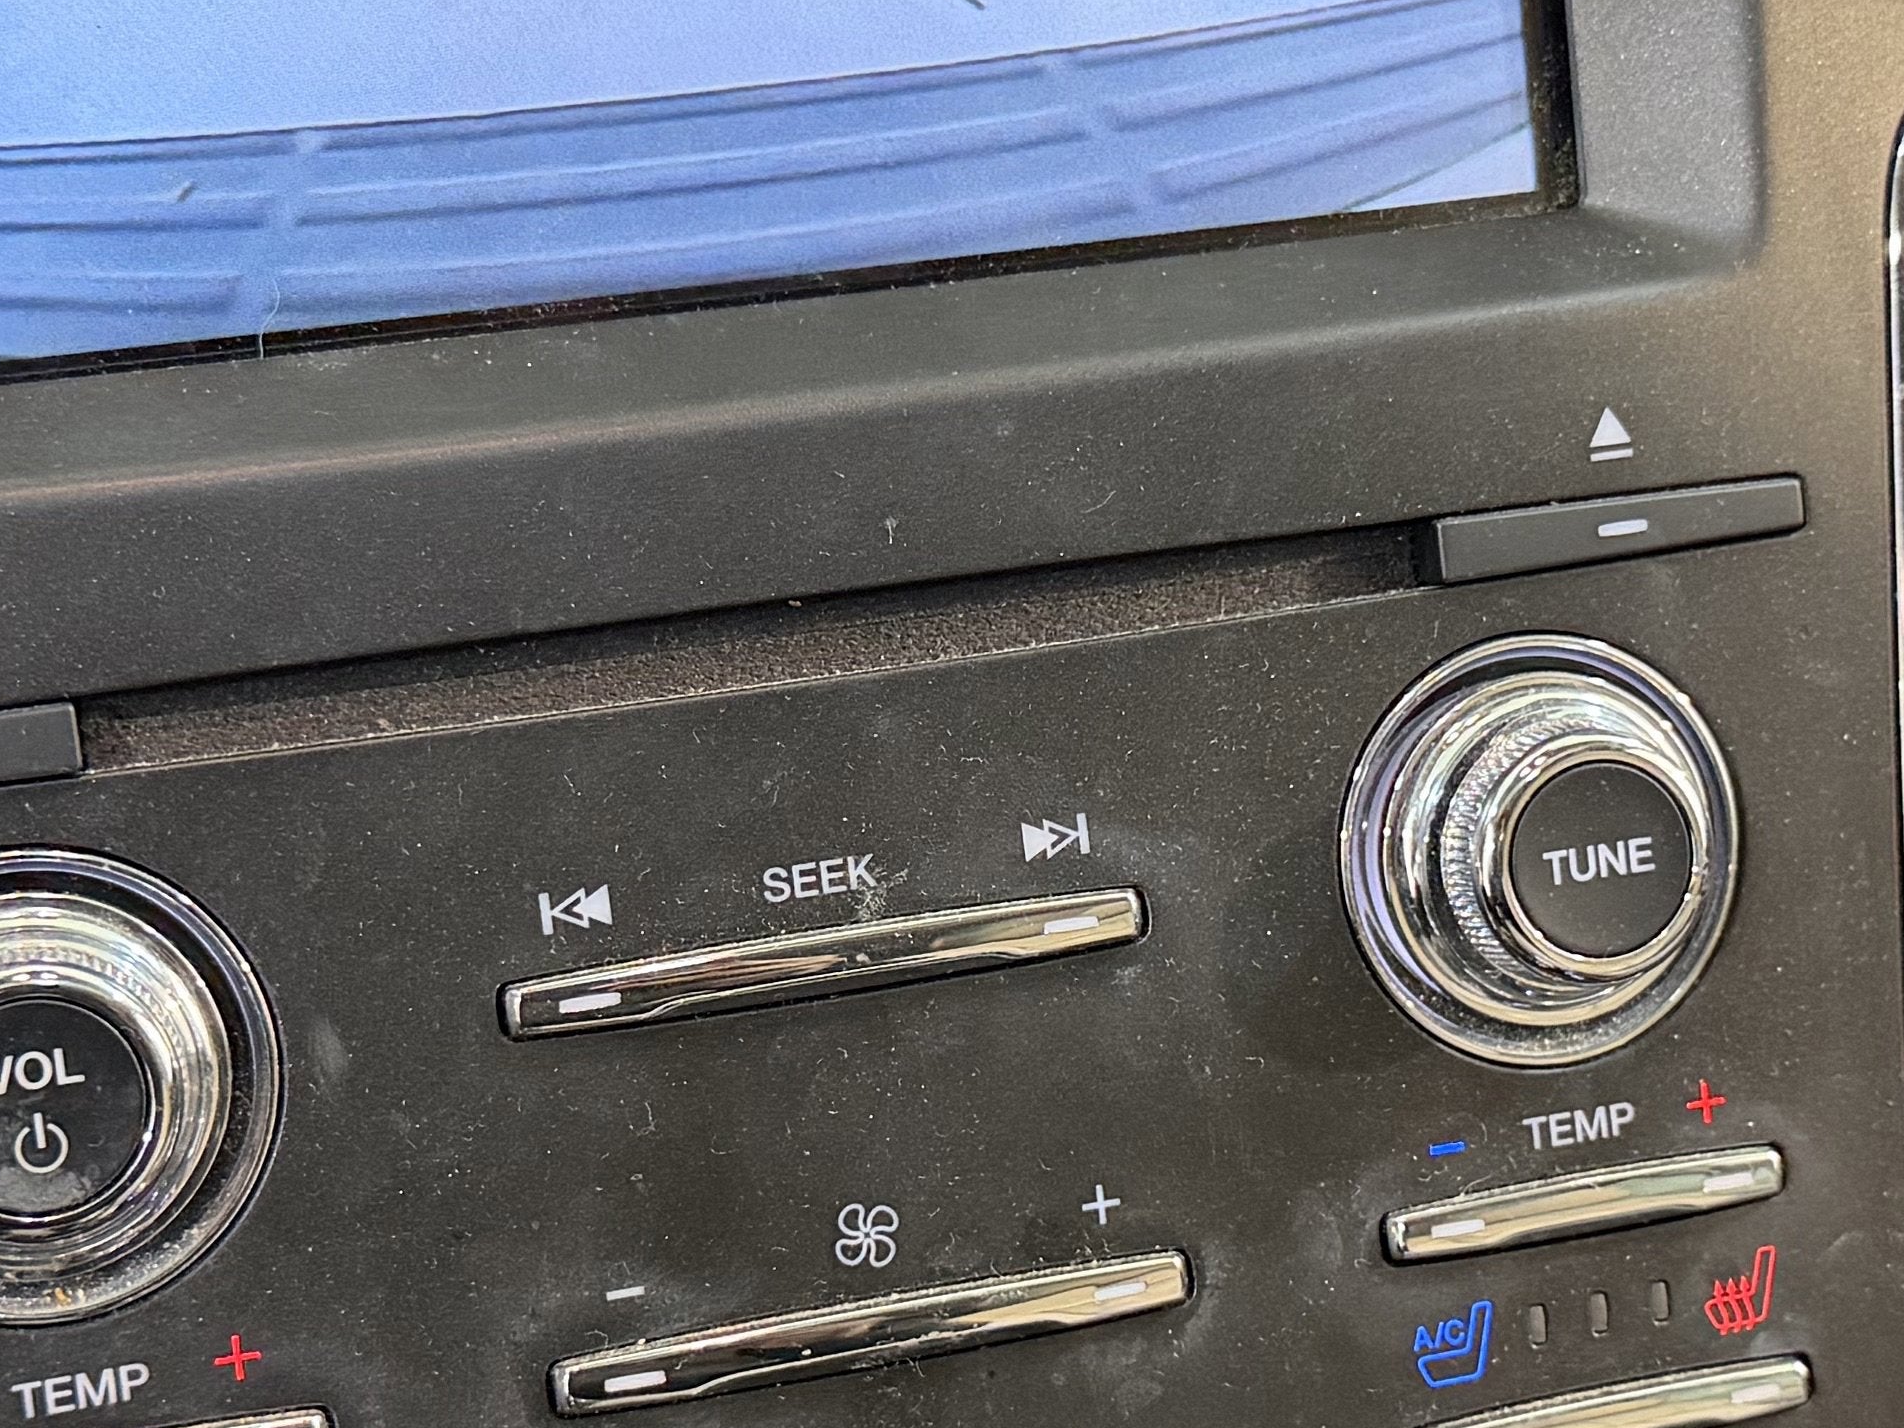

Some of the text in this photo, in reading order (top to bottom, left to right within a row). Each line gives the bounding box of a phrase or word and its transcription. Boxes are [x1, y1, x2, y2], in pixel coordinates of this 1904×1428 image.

[762, 854, 878, 904] SEEK
[1542, 836, 1658, 885] TUNE
[1522, 1101, 1636, 1150] TEMP
[1413, 1317, 1465, 1352] A/C
[10, 1363, 151, 1420] TEMP
